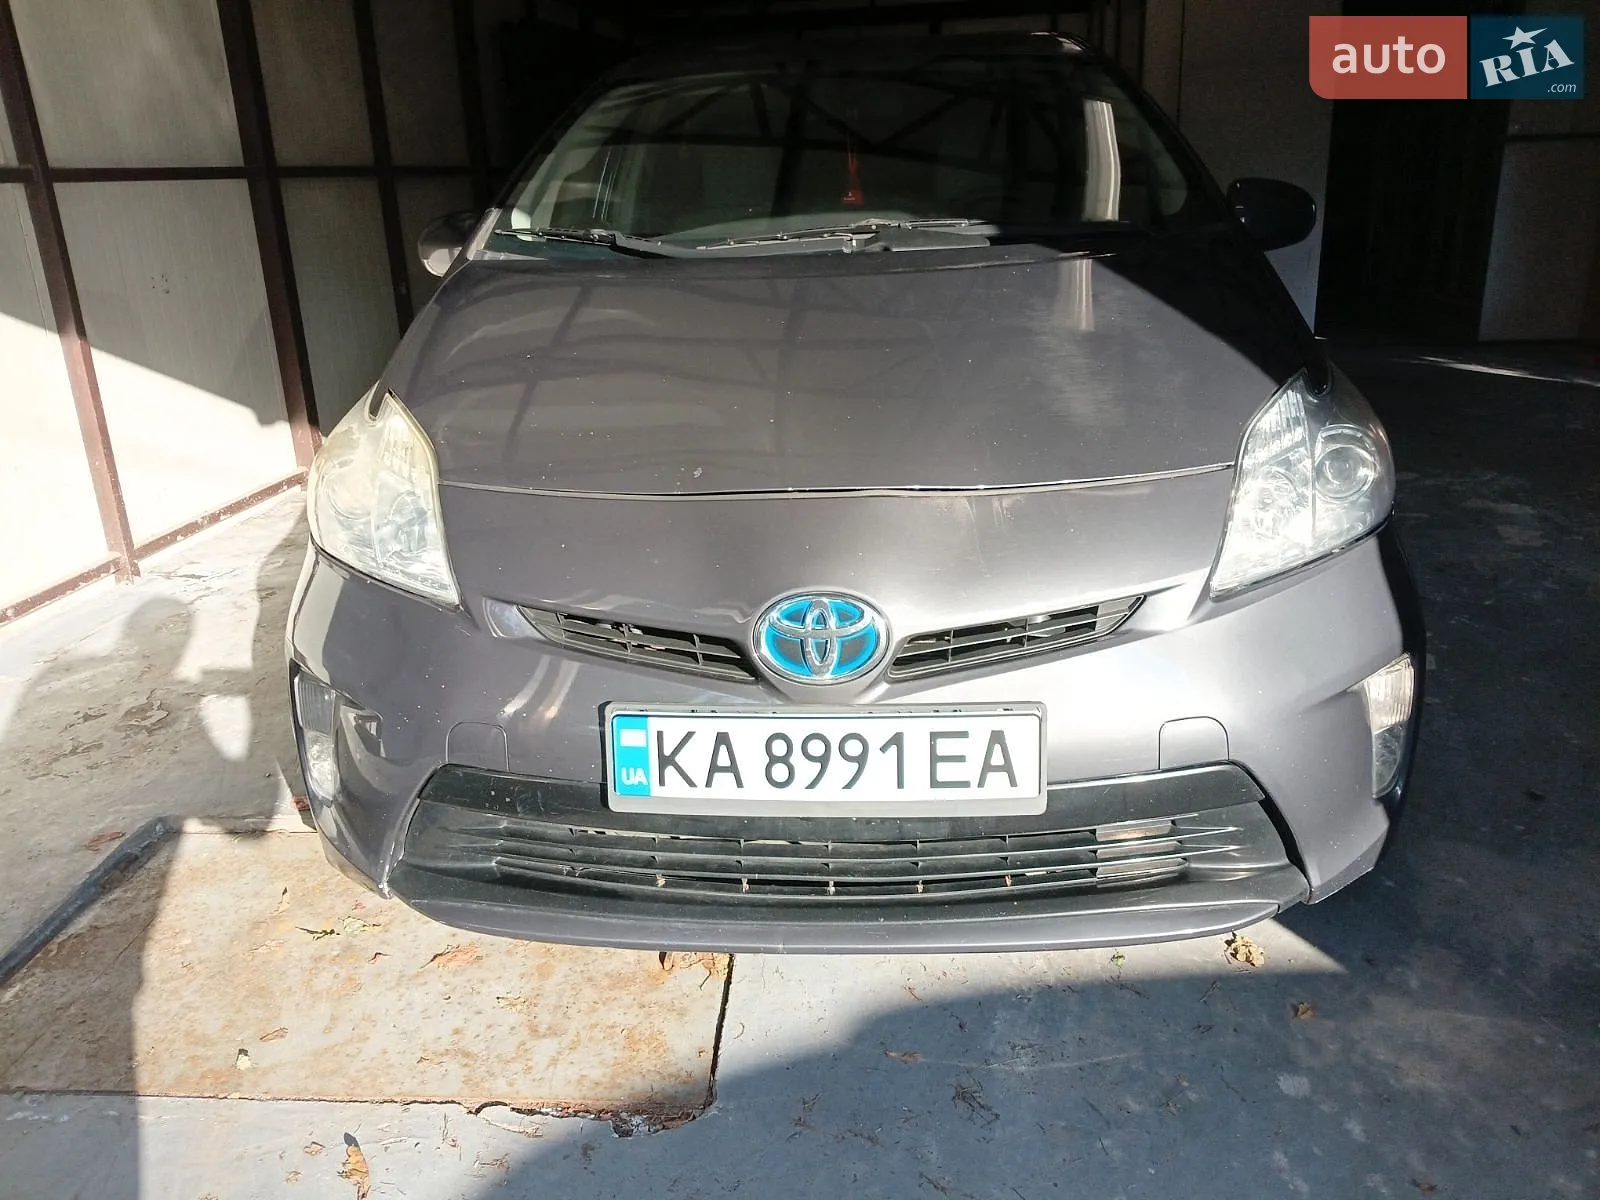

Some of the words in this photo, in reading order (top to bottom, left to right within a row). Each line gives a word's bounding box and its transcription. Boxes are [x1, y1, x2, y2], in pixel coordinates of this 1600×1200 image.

[621, 767, 648, 786] UA
[656, 730, 744, 789] KA
[765, 731, 905, 790] 8991
[929, 730, 1018, 788] EA
